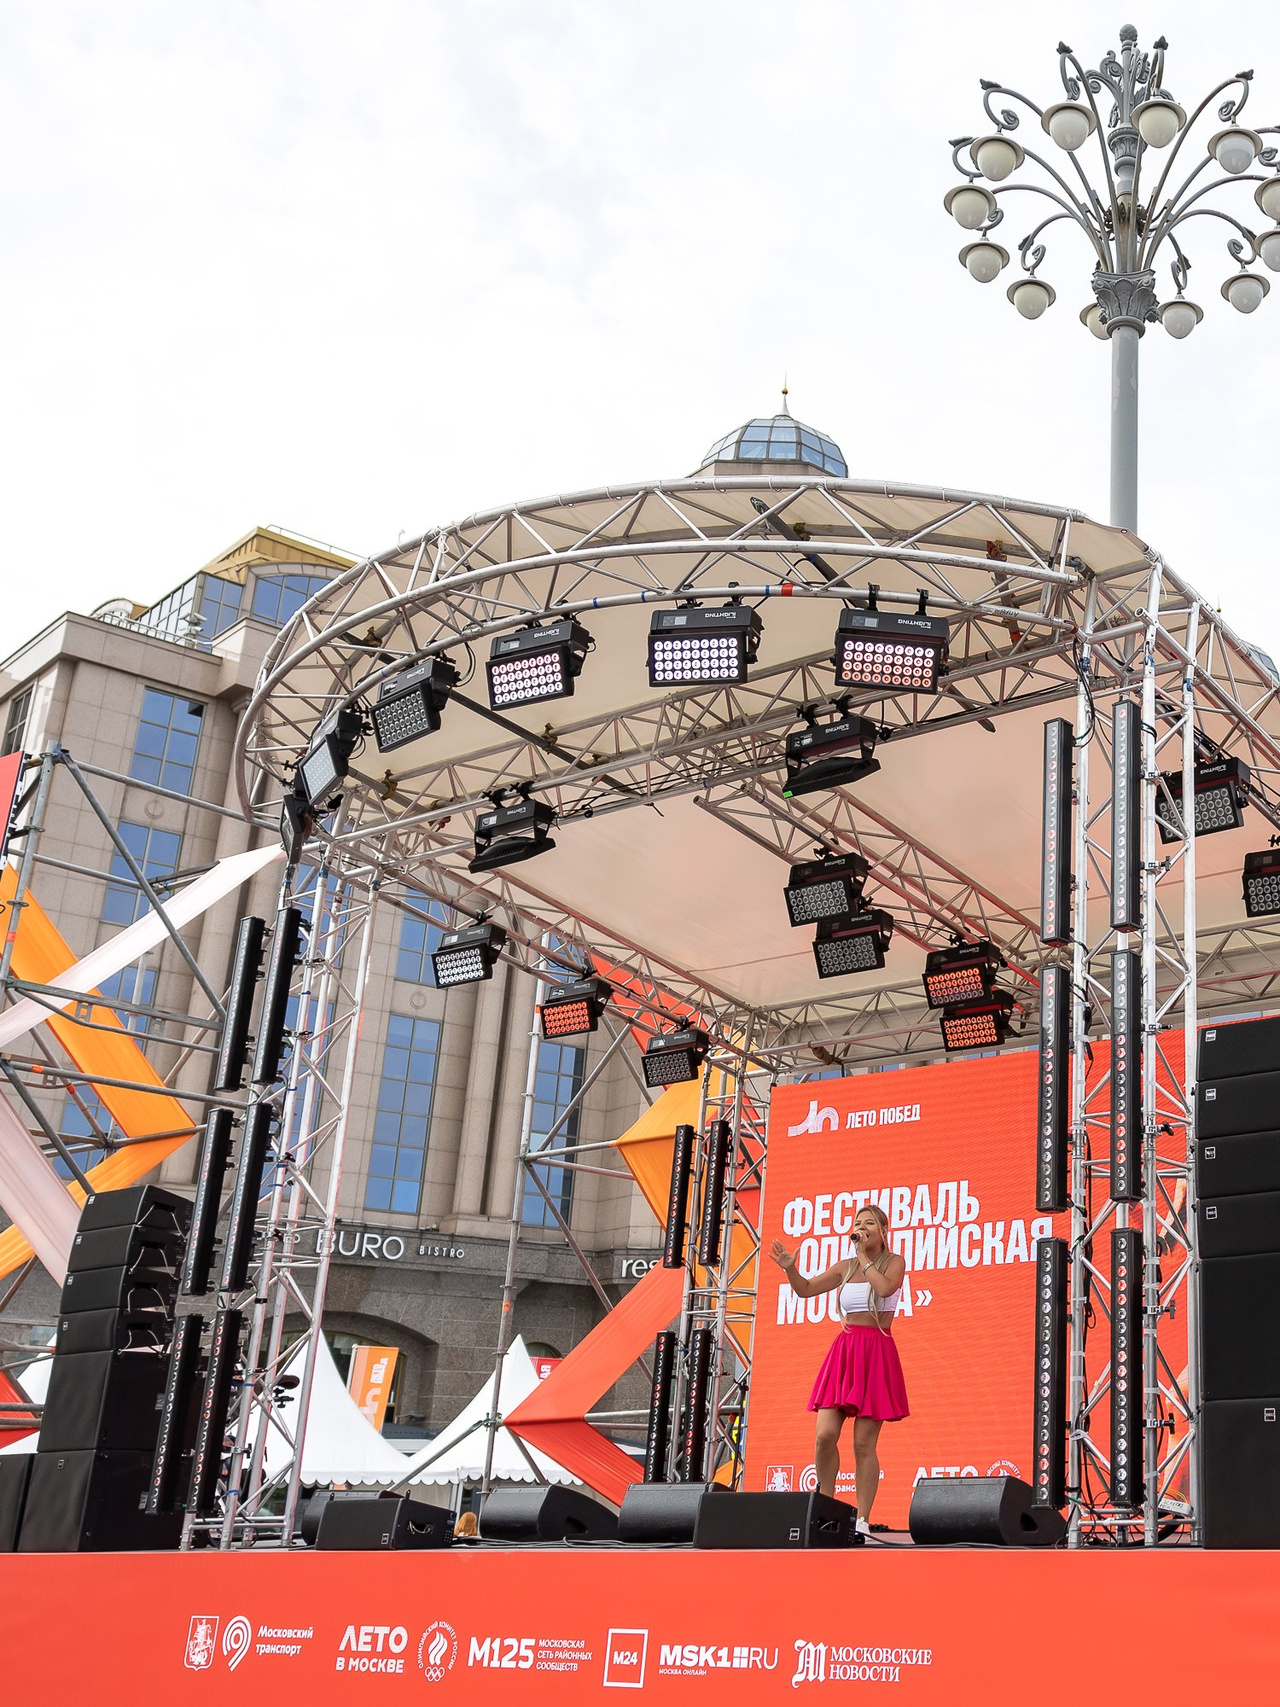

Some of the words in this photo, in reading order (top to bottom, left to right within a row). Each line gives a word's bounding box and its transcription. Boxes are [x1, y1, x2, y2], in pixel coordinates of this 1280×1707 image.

[845, 1110, 877, 1129] ЛЕТО
[879, 1104, 921, 1125] ПОБЕД
[419, 1245, 465, 1259] BISTRO
[257, 1625, 314, 1639] Московский
[338, 1625, 408, 1653] ЛЕТО
[255, 1644, 302, 1657] транспорт
[538, 1639, 585, 1649] МОСКОВСКАЯ
[467, 1636, 536, 1669] М125
[537, 1651, 554, 1659] СЕТЬ
[554, 1650, 593, 1660] РАЙОННЫХ
[613, 1651, 638, 1665] М24
[830, 1646, 933, 1665] МОСКОВСКИЕ
[335, 1657, 346, 1671] В
[348, 1657, 405, 1673] МОСКВЕ
[536, 1661, 578, 1672] СООБЩЕСТВ
[682, 1668, 707, 1676] ОНЛАЙН
[829, 1664, 900, 1682] НОВОСТИ
